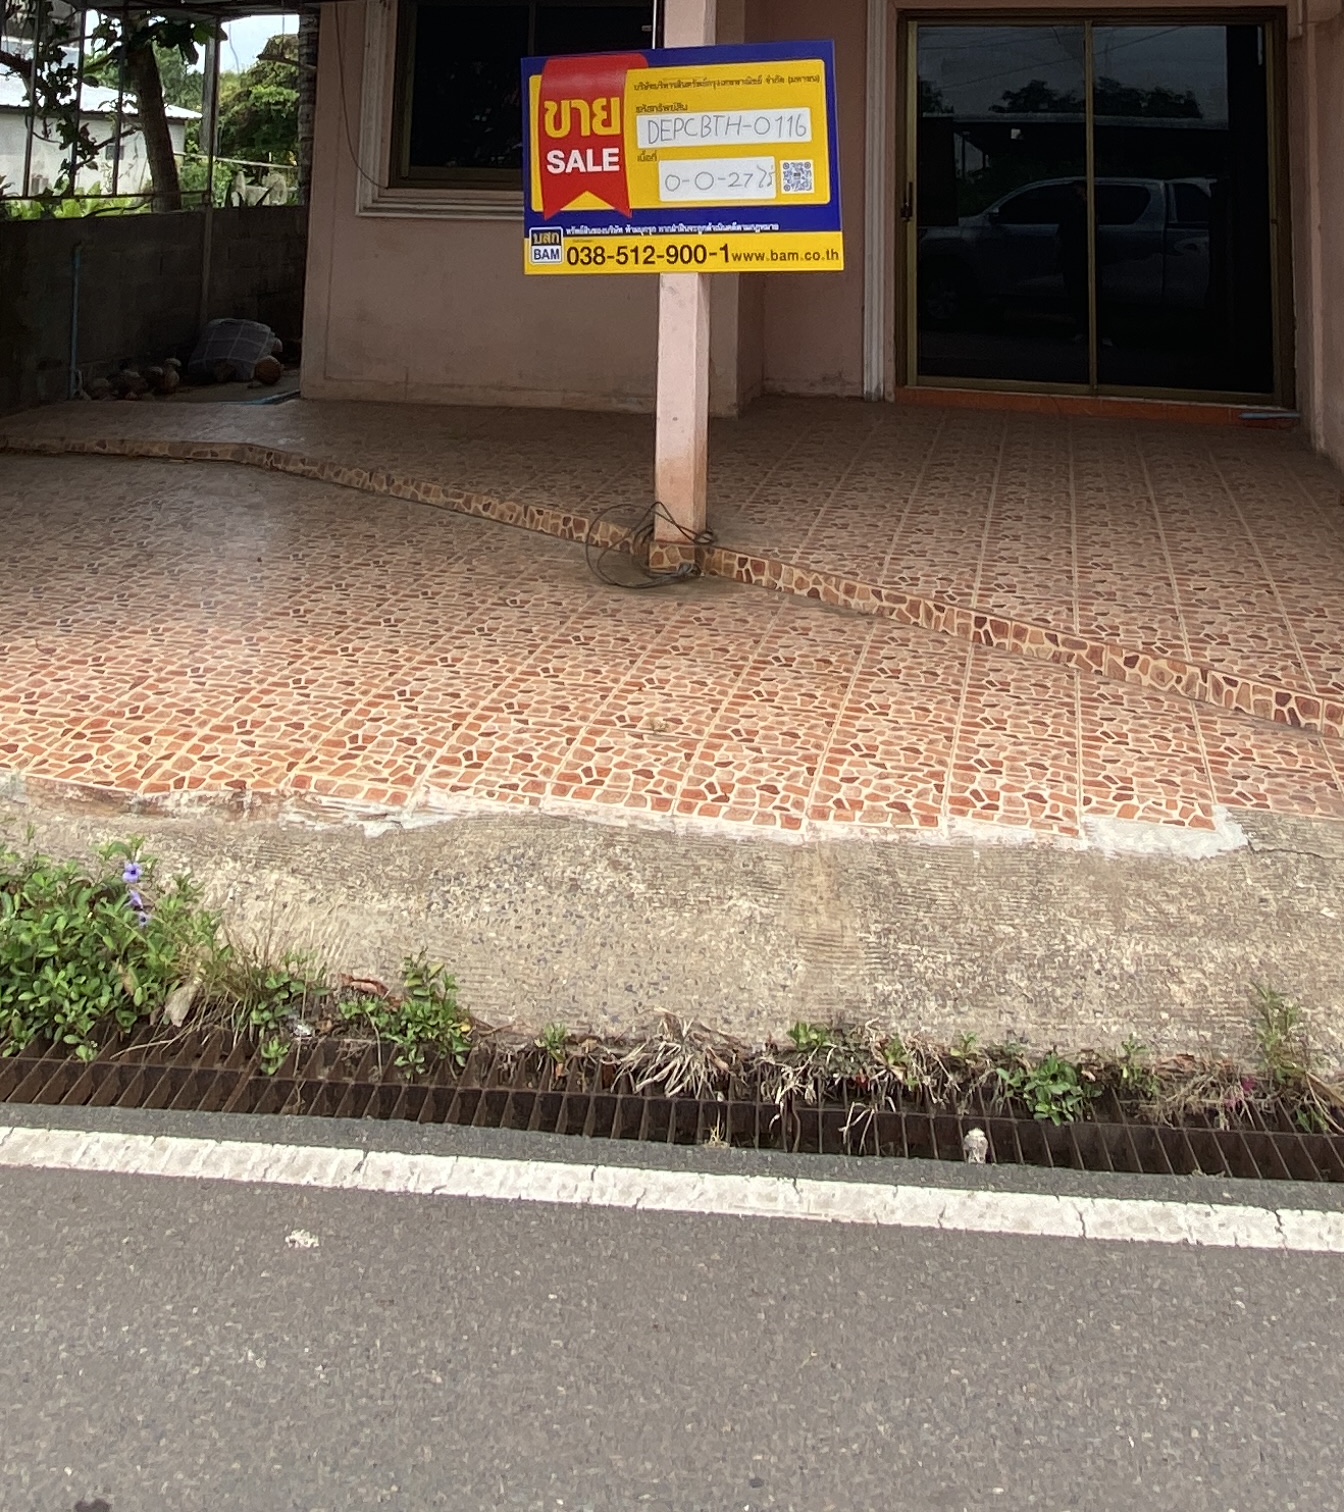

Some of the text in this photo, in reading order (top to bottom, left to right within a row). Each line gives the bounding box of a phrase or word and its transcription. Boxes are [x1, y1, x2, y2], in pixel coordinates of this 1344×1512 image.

[544, 96, 621, 138] ขาย
[647, 114, 807, 144] DEPCBTH-0116
[546, 147, 620, 174] SALE
[533, 248, 560, 260] BAM
[567, 244, 840, 265] 038-512-900-1 www.bam.co.th
